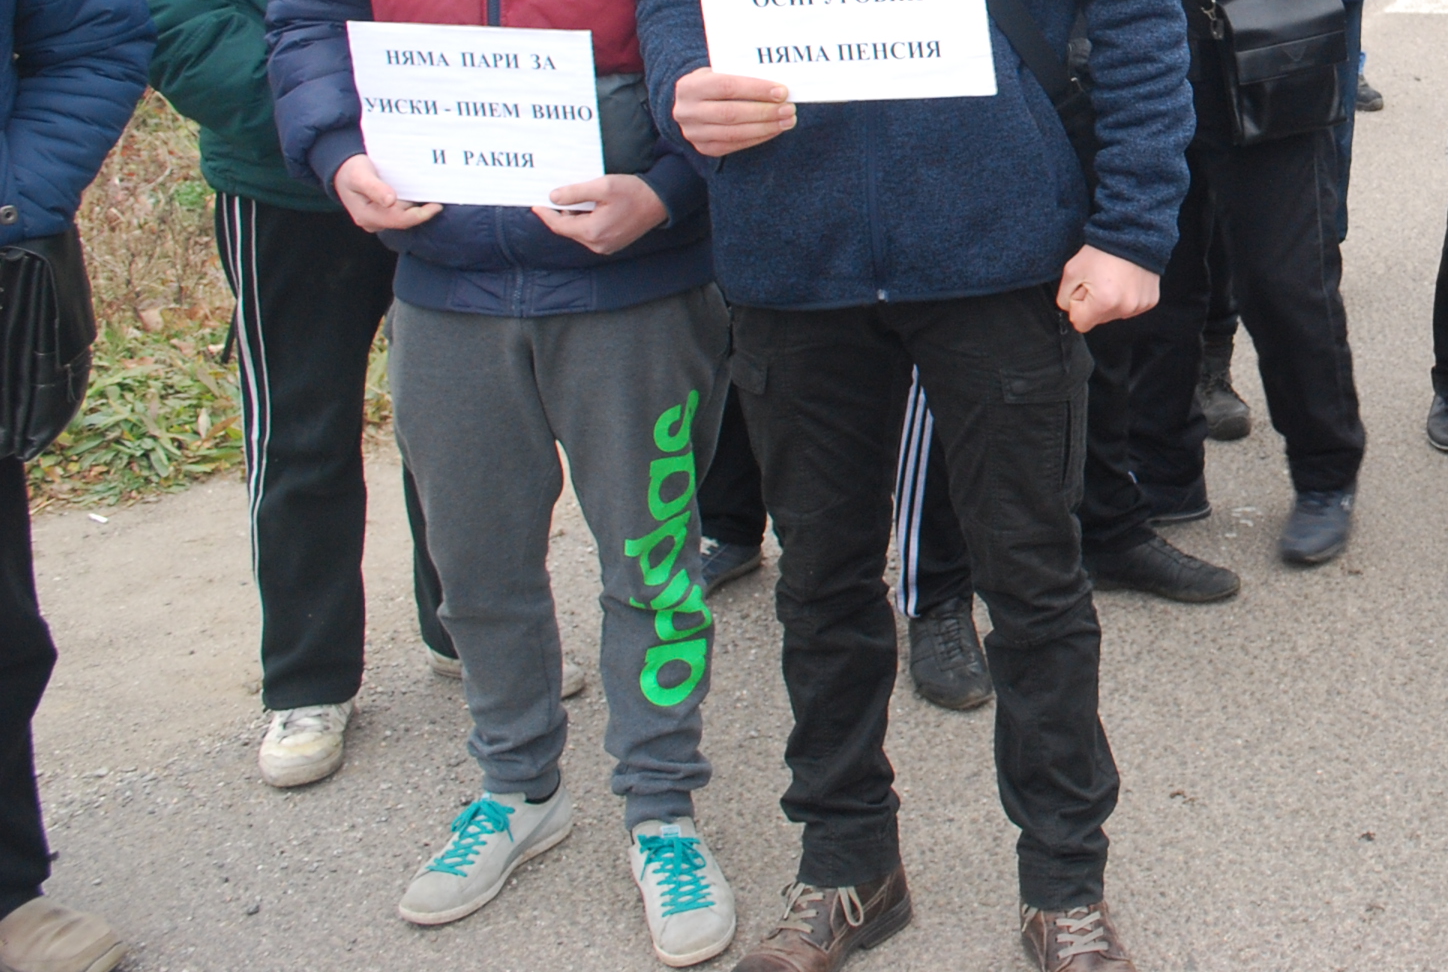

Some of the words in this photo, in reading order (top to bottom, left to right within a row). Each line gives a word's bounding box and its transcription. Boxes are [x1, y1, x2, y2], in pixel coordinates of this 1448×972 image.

[385, 49, 451, 67] НЯМА
[460, 51, 520, 70] ПАРИ
[530, 53, 557, 71] ЗА
[756, 44, 831, 65] НЯМА
[837, 40, 942, 62] ПЕНСИЯ
[531, 103, 594, 122] ВИНО
[432, 148, 447, 165] И
[463, 150, 535, 169] РАКИЯ
